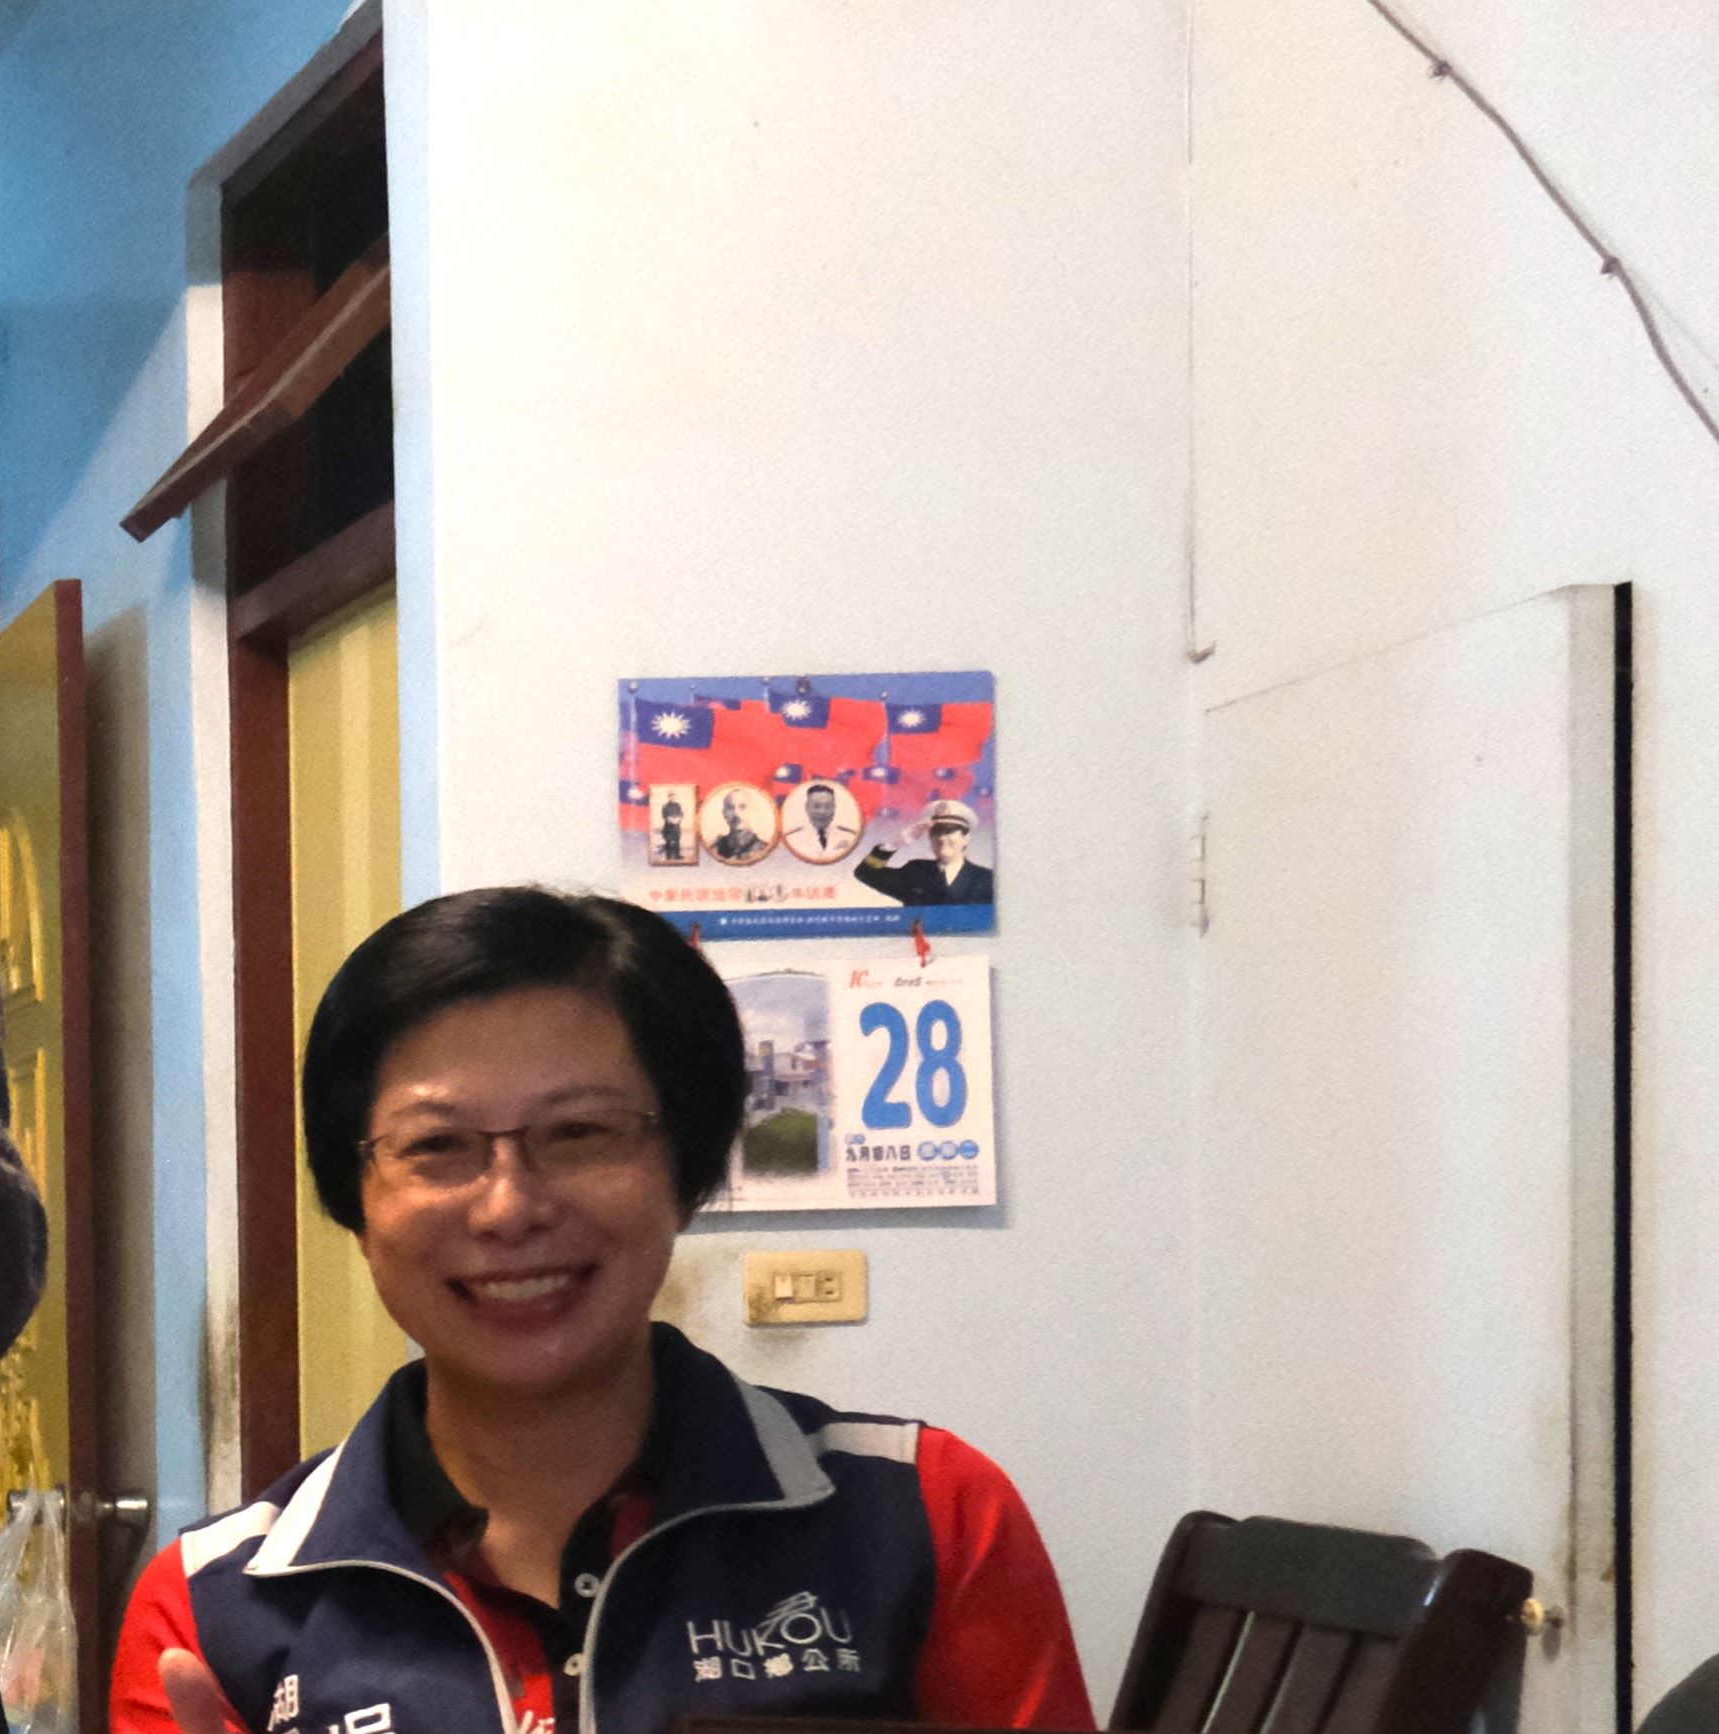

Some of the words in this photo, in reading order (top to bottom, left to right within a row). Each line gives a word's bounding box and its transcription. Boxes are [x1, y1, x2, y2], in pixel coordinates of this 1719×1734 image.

[859, 1000, 967, 1130] 28
[687, 1600, 854, 1657] HUKOU
[693, 1649, 861, 1682] 湖口鄉公所
